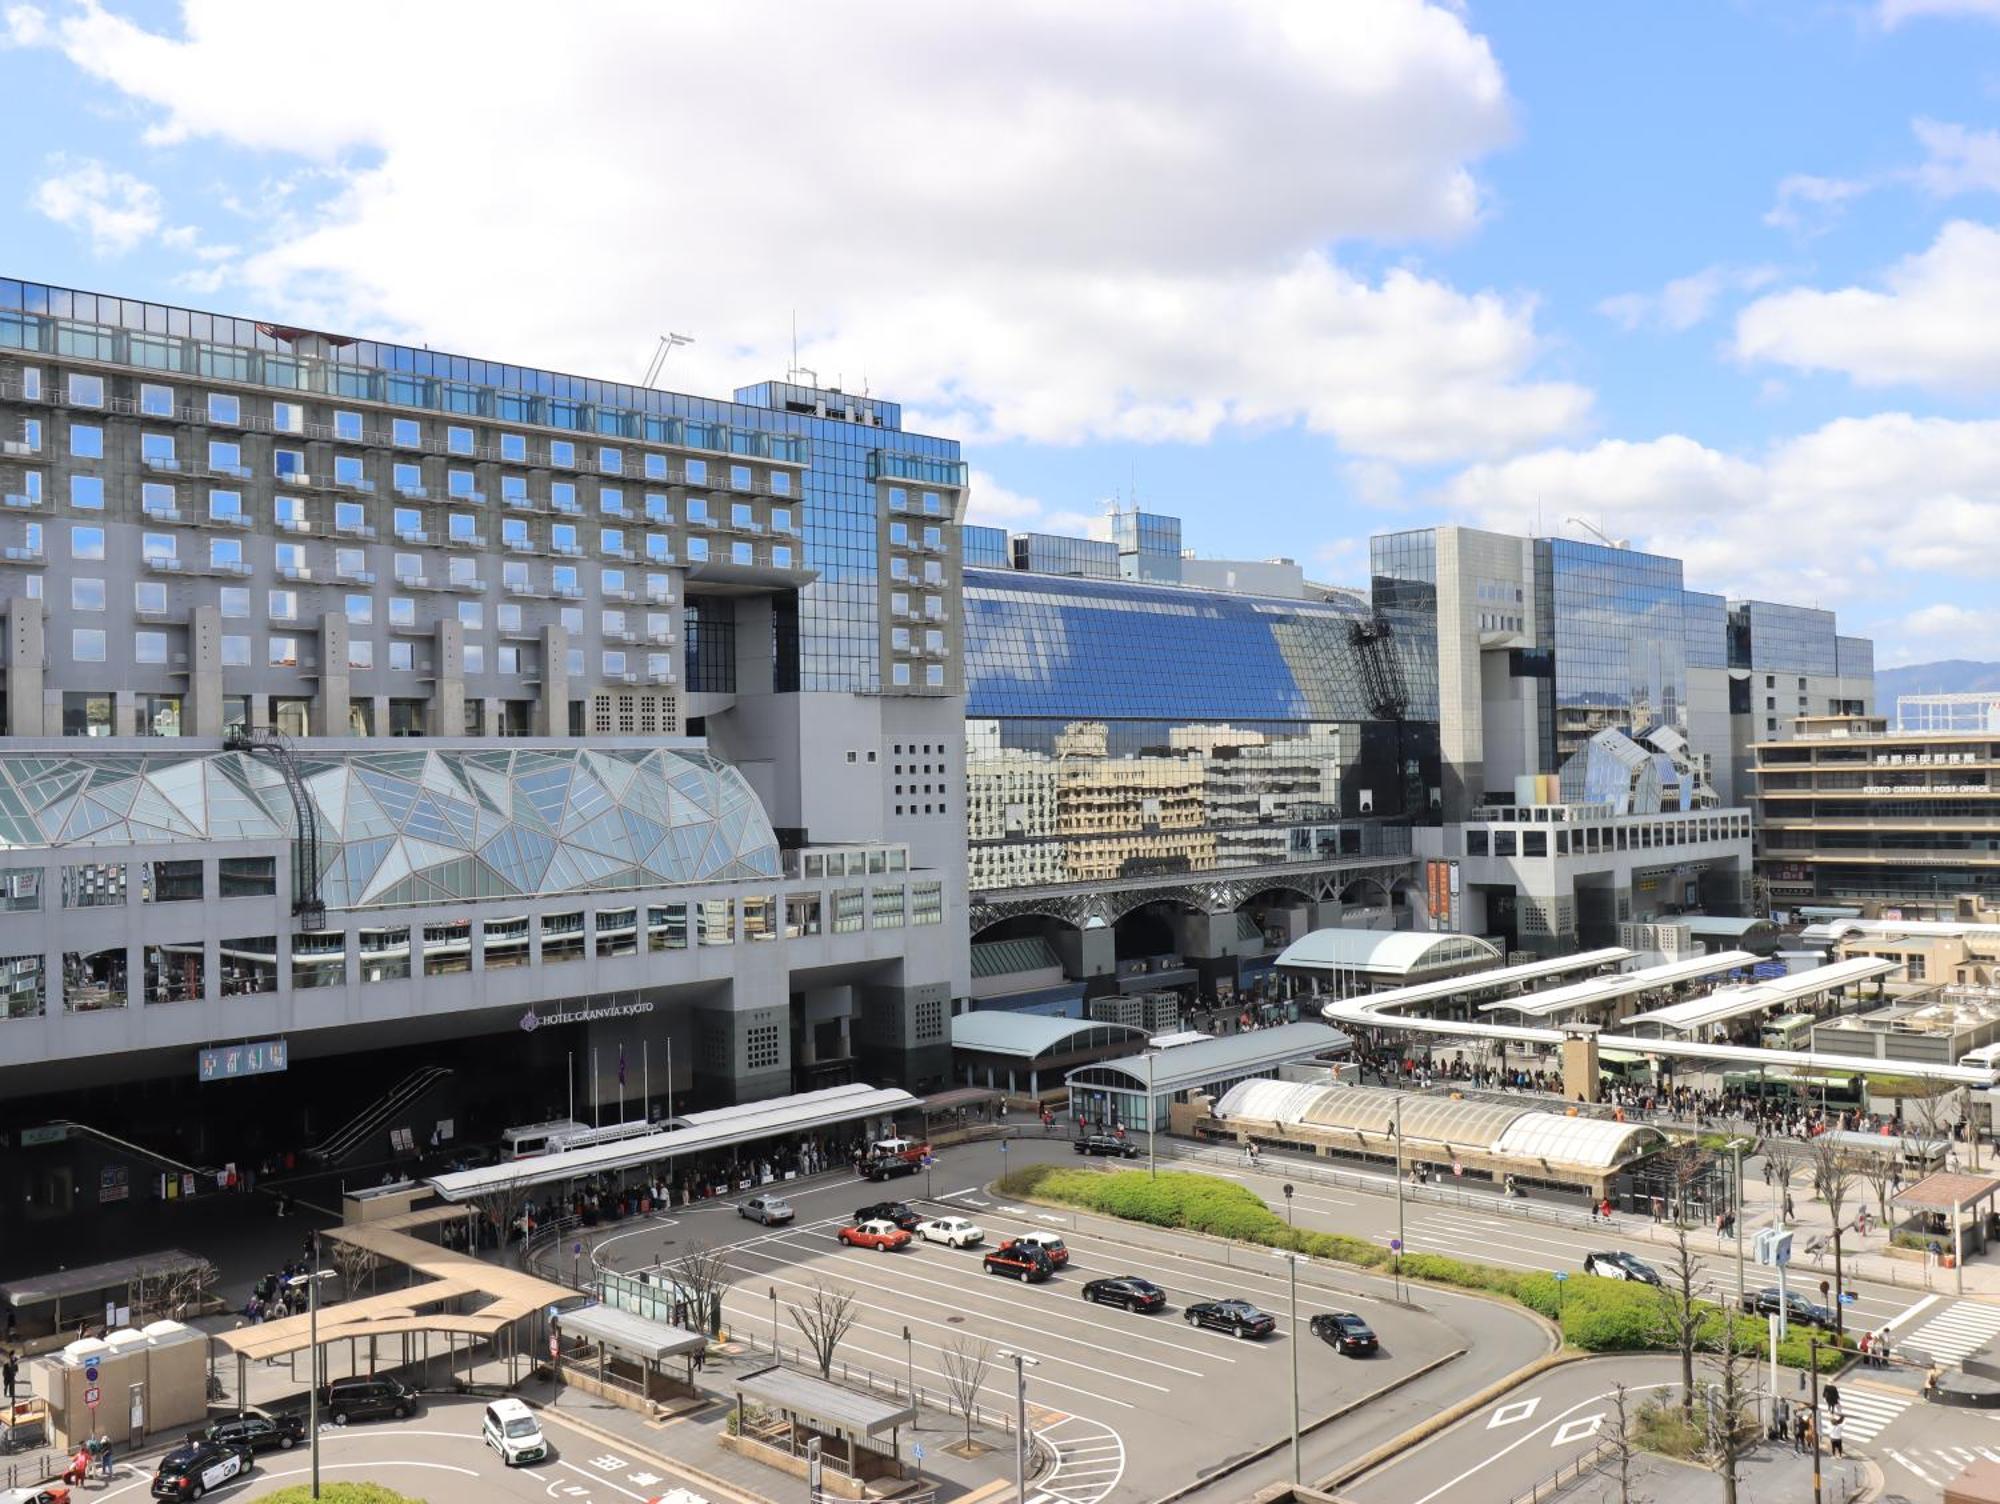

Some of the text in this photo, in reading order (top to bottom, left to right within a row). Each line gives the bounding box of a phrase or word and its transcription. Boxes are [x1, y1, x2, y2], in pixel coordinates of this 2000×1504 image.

[1933, 785, 1956, 793] POST
[1959, 784, 1990, 793] OFFICE
[543, 1012, 573, 1025] HOTEL
[576, 1007, 621, 1021] GRANVIA
